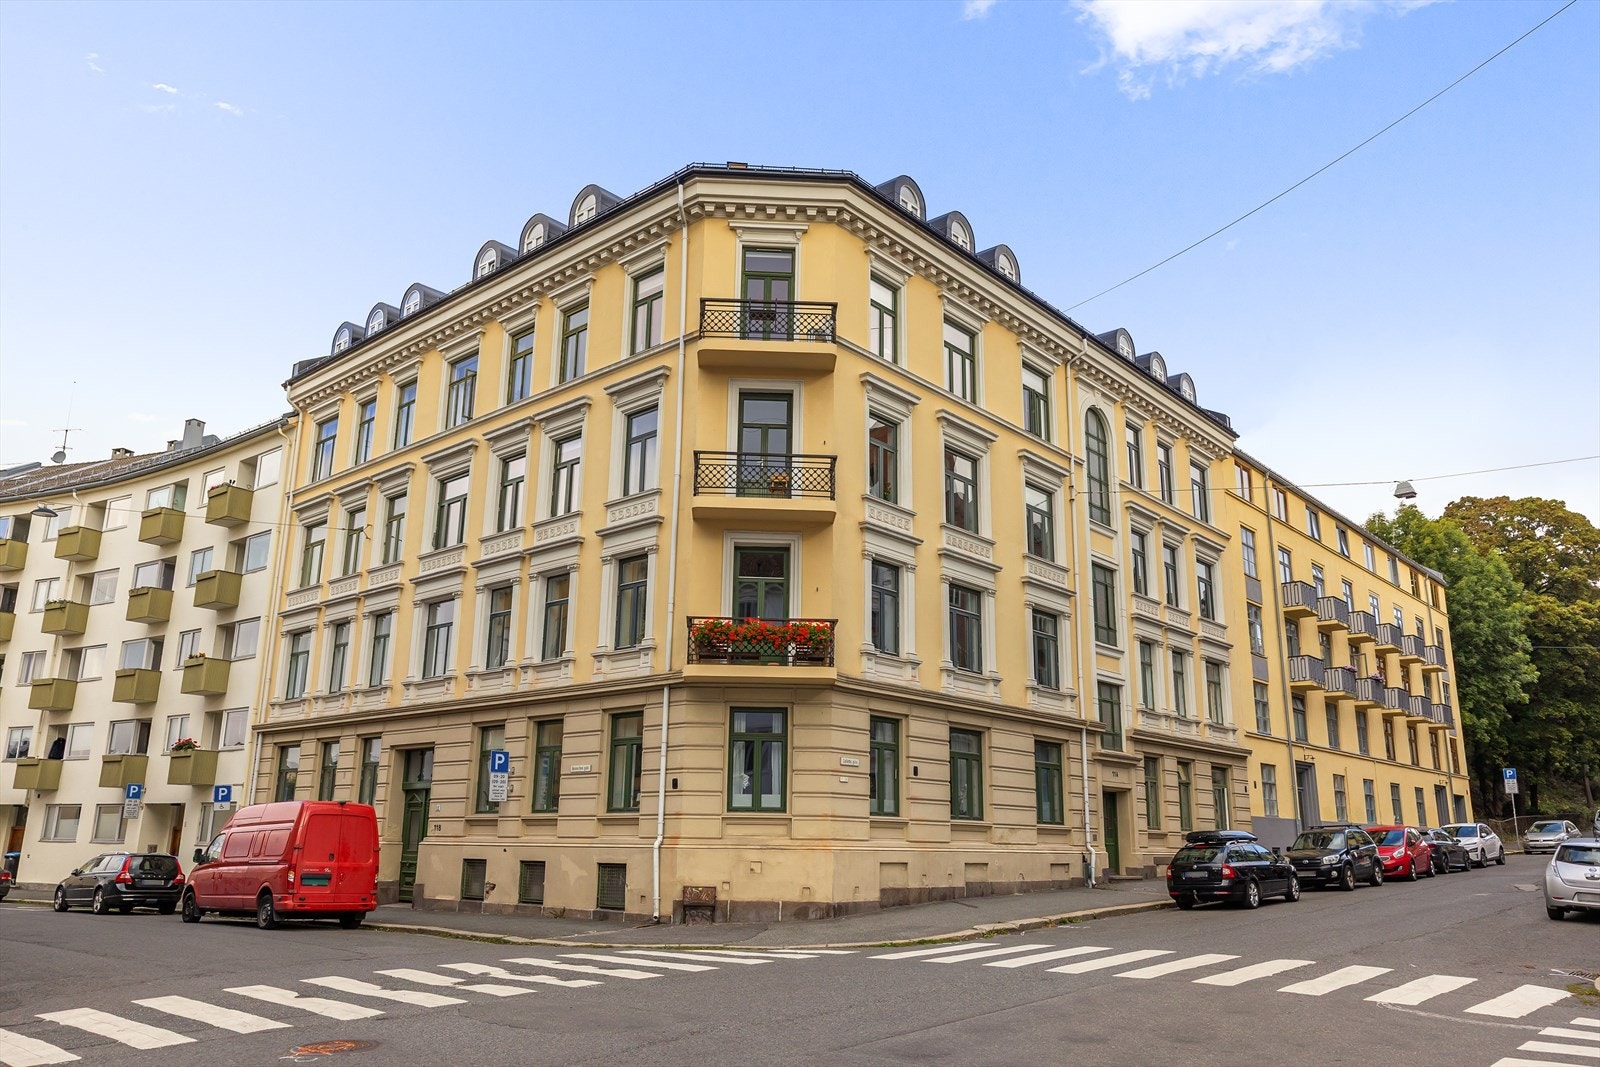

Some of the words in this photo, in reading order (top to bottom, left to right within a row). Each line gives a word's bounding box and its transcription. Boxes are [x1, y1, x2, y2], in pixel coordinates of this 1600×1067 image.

[495, 753, 505, 770] P
[1507, 769, 1513, 778] P
[130, 785, 138, 797] P
[218, 787, 227, 801] P
